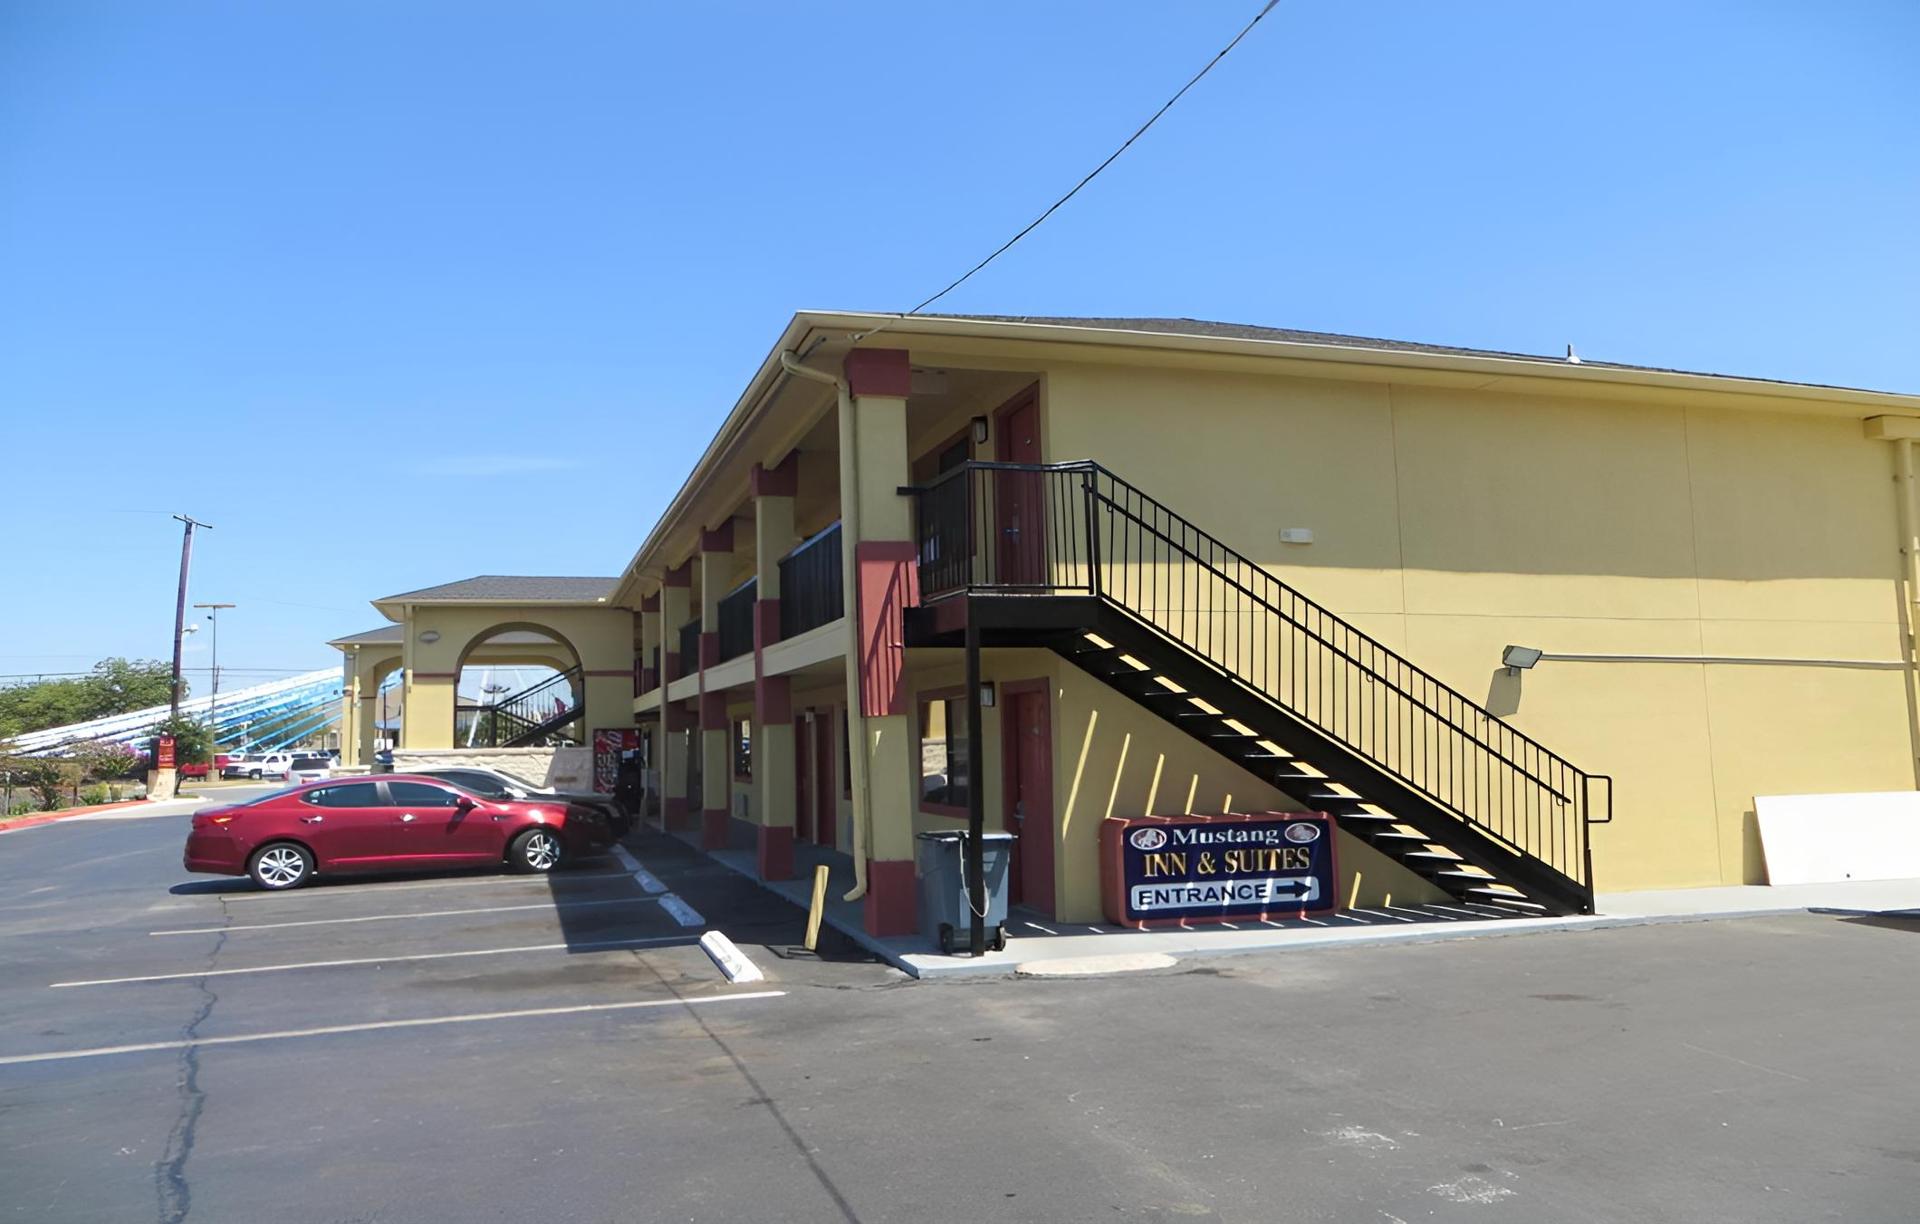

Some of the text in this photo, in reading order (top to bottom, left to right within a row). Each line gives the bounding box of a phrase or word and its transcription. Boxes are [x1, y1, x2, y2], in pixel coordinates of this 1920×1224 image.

[1173, 827, 1280, 846] Mustang
[1143, 847, 1311, 877] INN & SUITES
[1138, 883, 1268, 906] ENTRANCE
